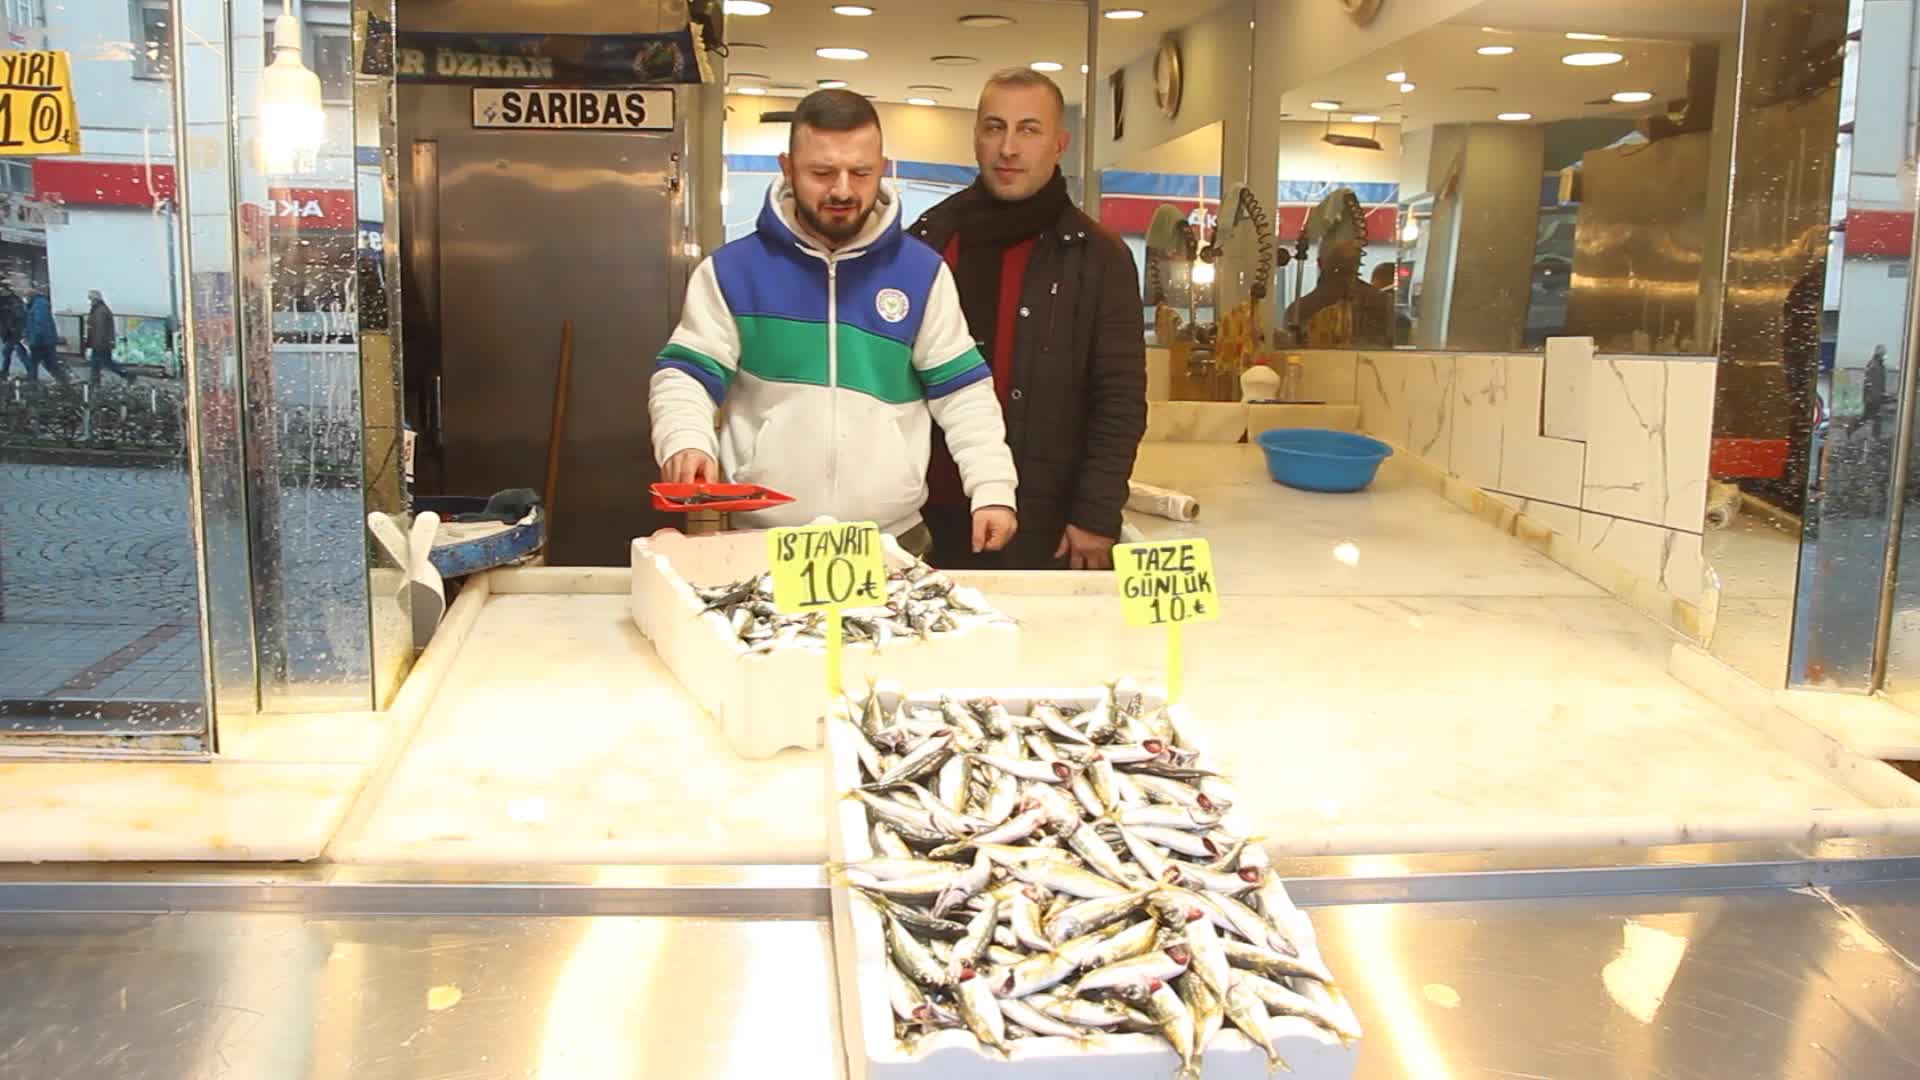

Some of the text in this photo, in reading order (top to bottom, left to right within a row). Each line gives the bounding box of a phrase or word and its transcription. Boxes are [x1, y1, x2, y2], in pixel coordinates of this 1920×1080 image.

[436, 48, 554, 78] ÖZKAN
[502, 91, 646, 127] SARIBAŞ
[1130, 545, 1196, 572] TAZE
[1124, 570, 1213, 599] GÜNLÜK
